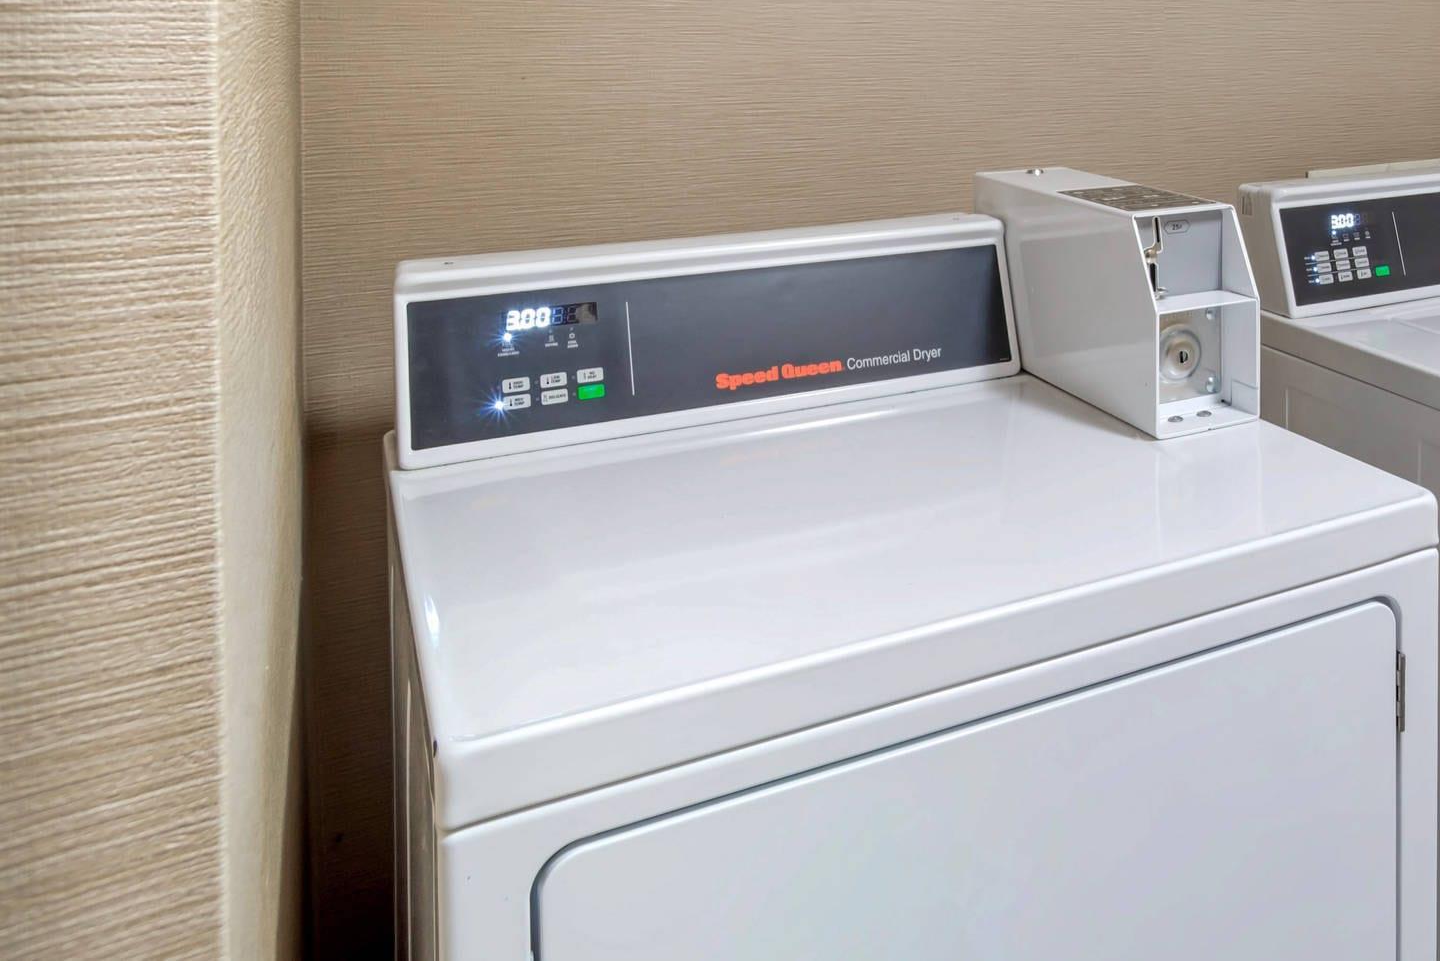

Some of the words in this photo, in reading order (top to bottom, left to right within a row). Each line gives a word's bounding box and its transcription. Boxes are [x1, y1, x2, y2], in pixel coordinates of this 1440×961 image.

[715, 366, 778, 390] Speed
[781, 359, 842, 379] Queen
[847, 349, 911, 370] Commercial
[913, 346, 942, 363] Dryer
